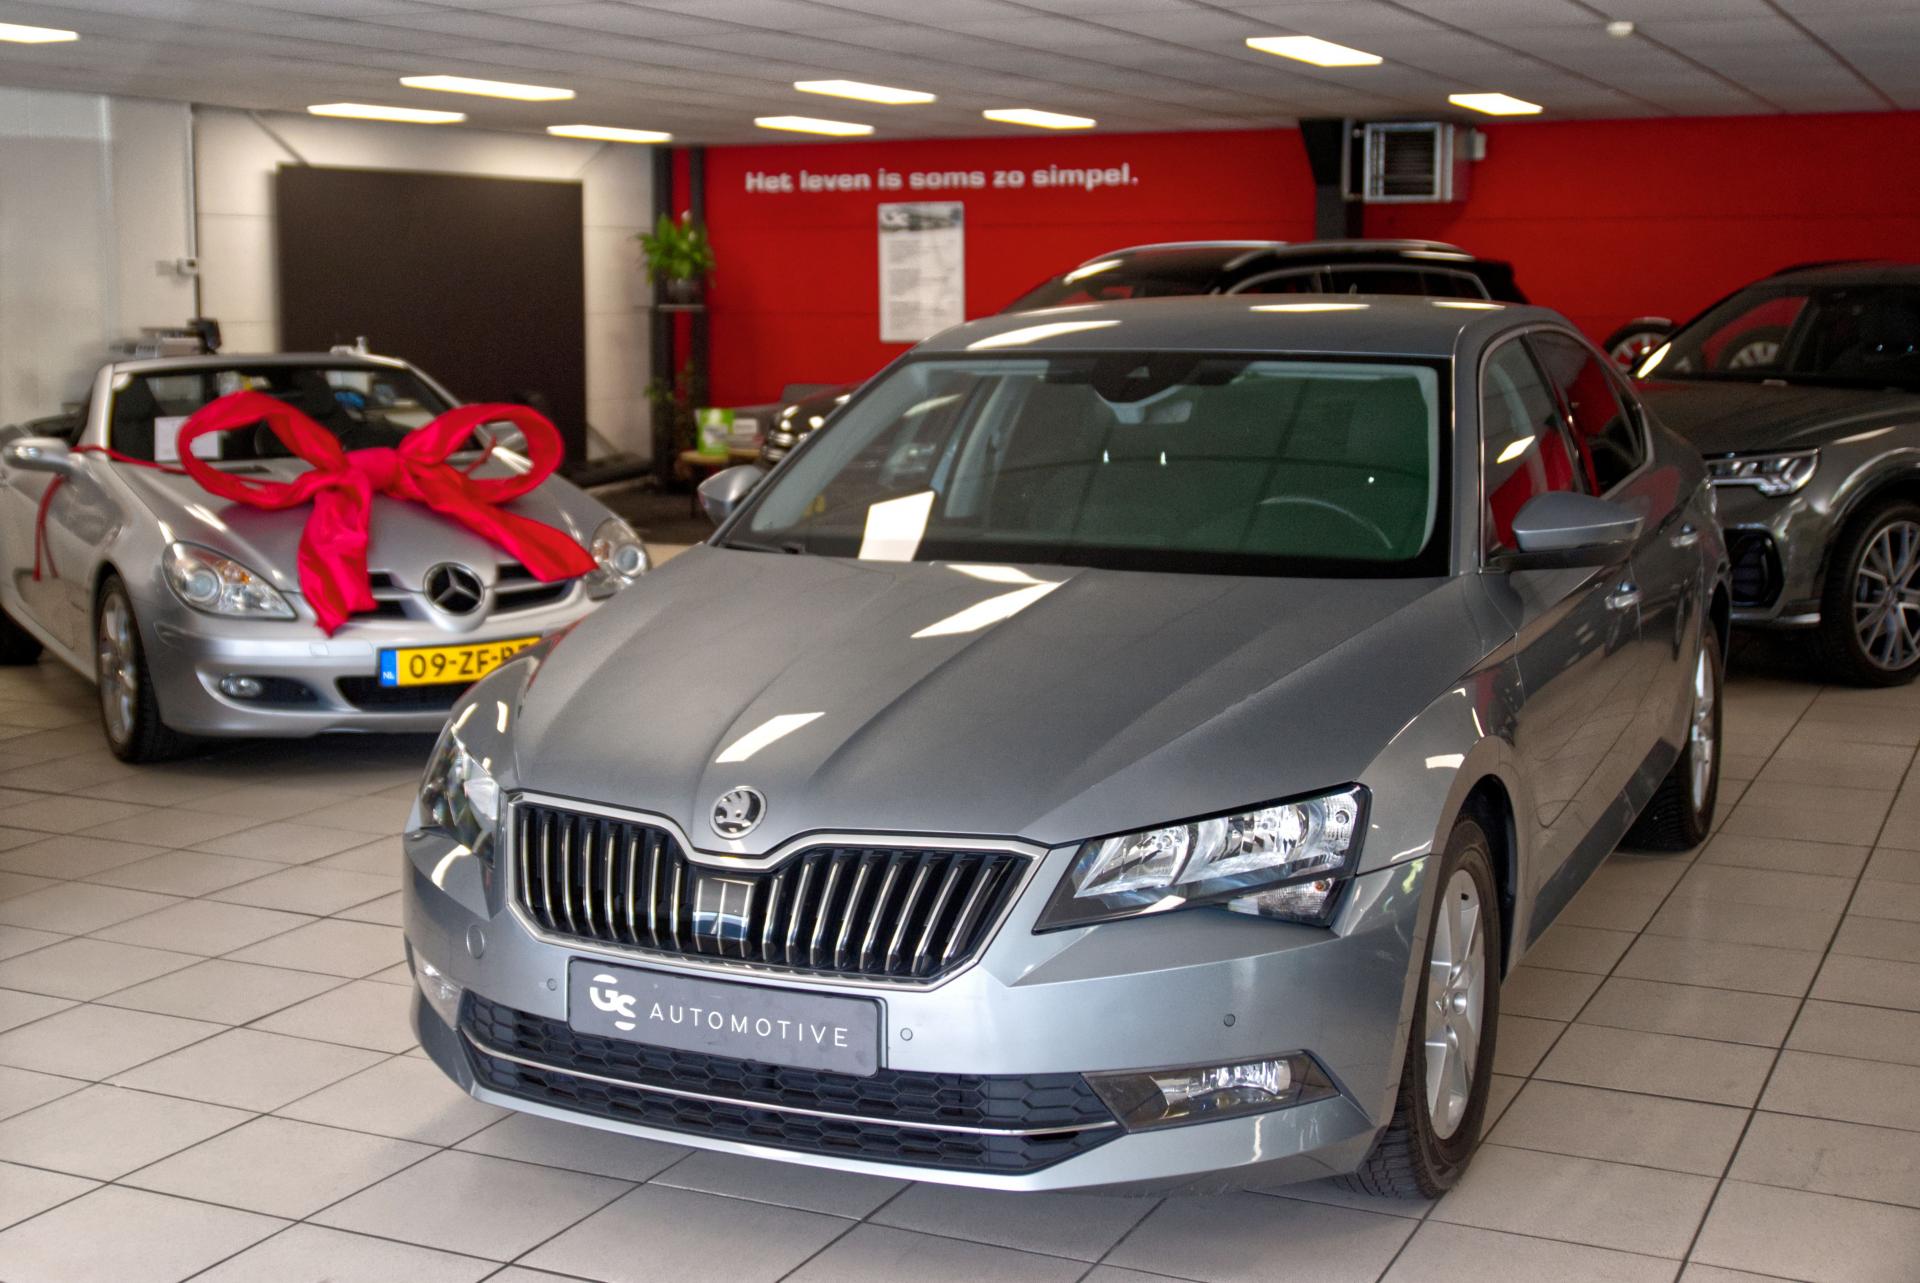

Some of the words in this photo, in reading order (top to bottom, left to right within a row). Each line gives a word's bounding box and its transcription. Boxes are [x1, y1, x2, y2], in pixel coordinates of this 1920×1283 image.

[745, 171, 794, 193] Het
[800, 169, 871, 192] leven
[878, 168, 902, 190] is
[909, 171, 985, 189] soms
[993, 170, 1025, 188] zo
[1032, 162, 1139, 191] simpel.
[650, 1003, 848, 1047] AUTOMOTIVE
